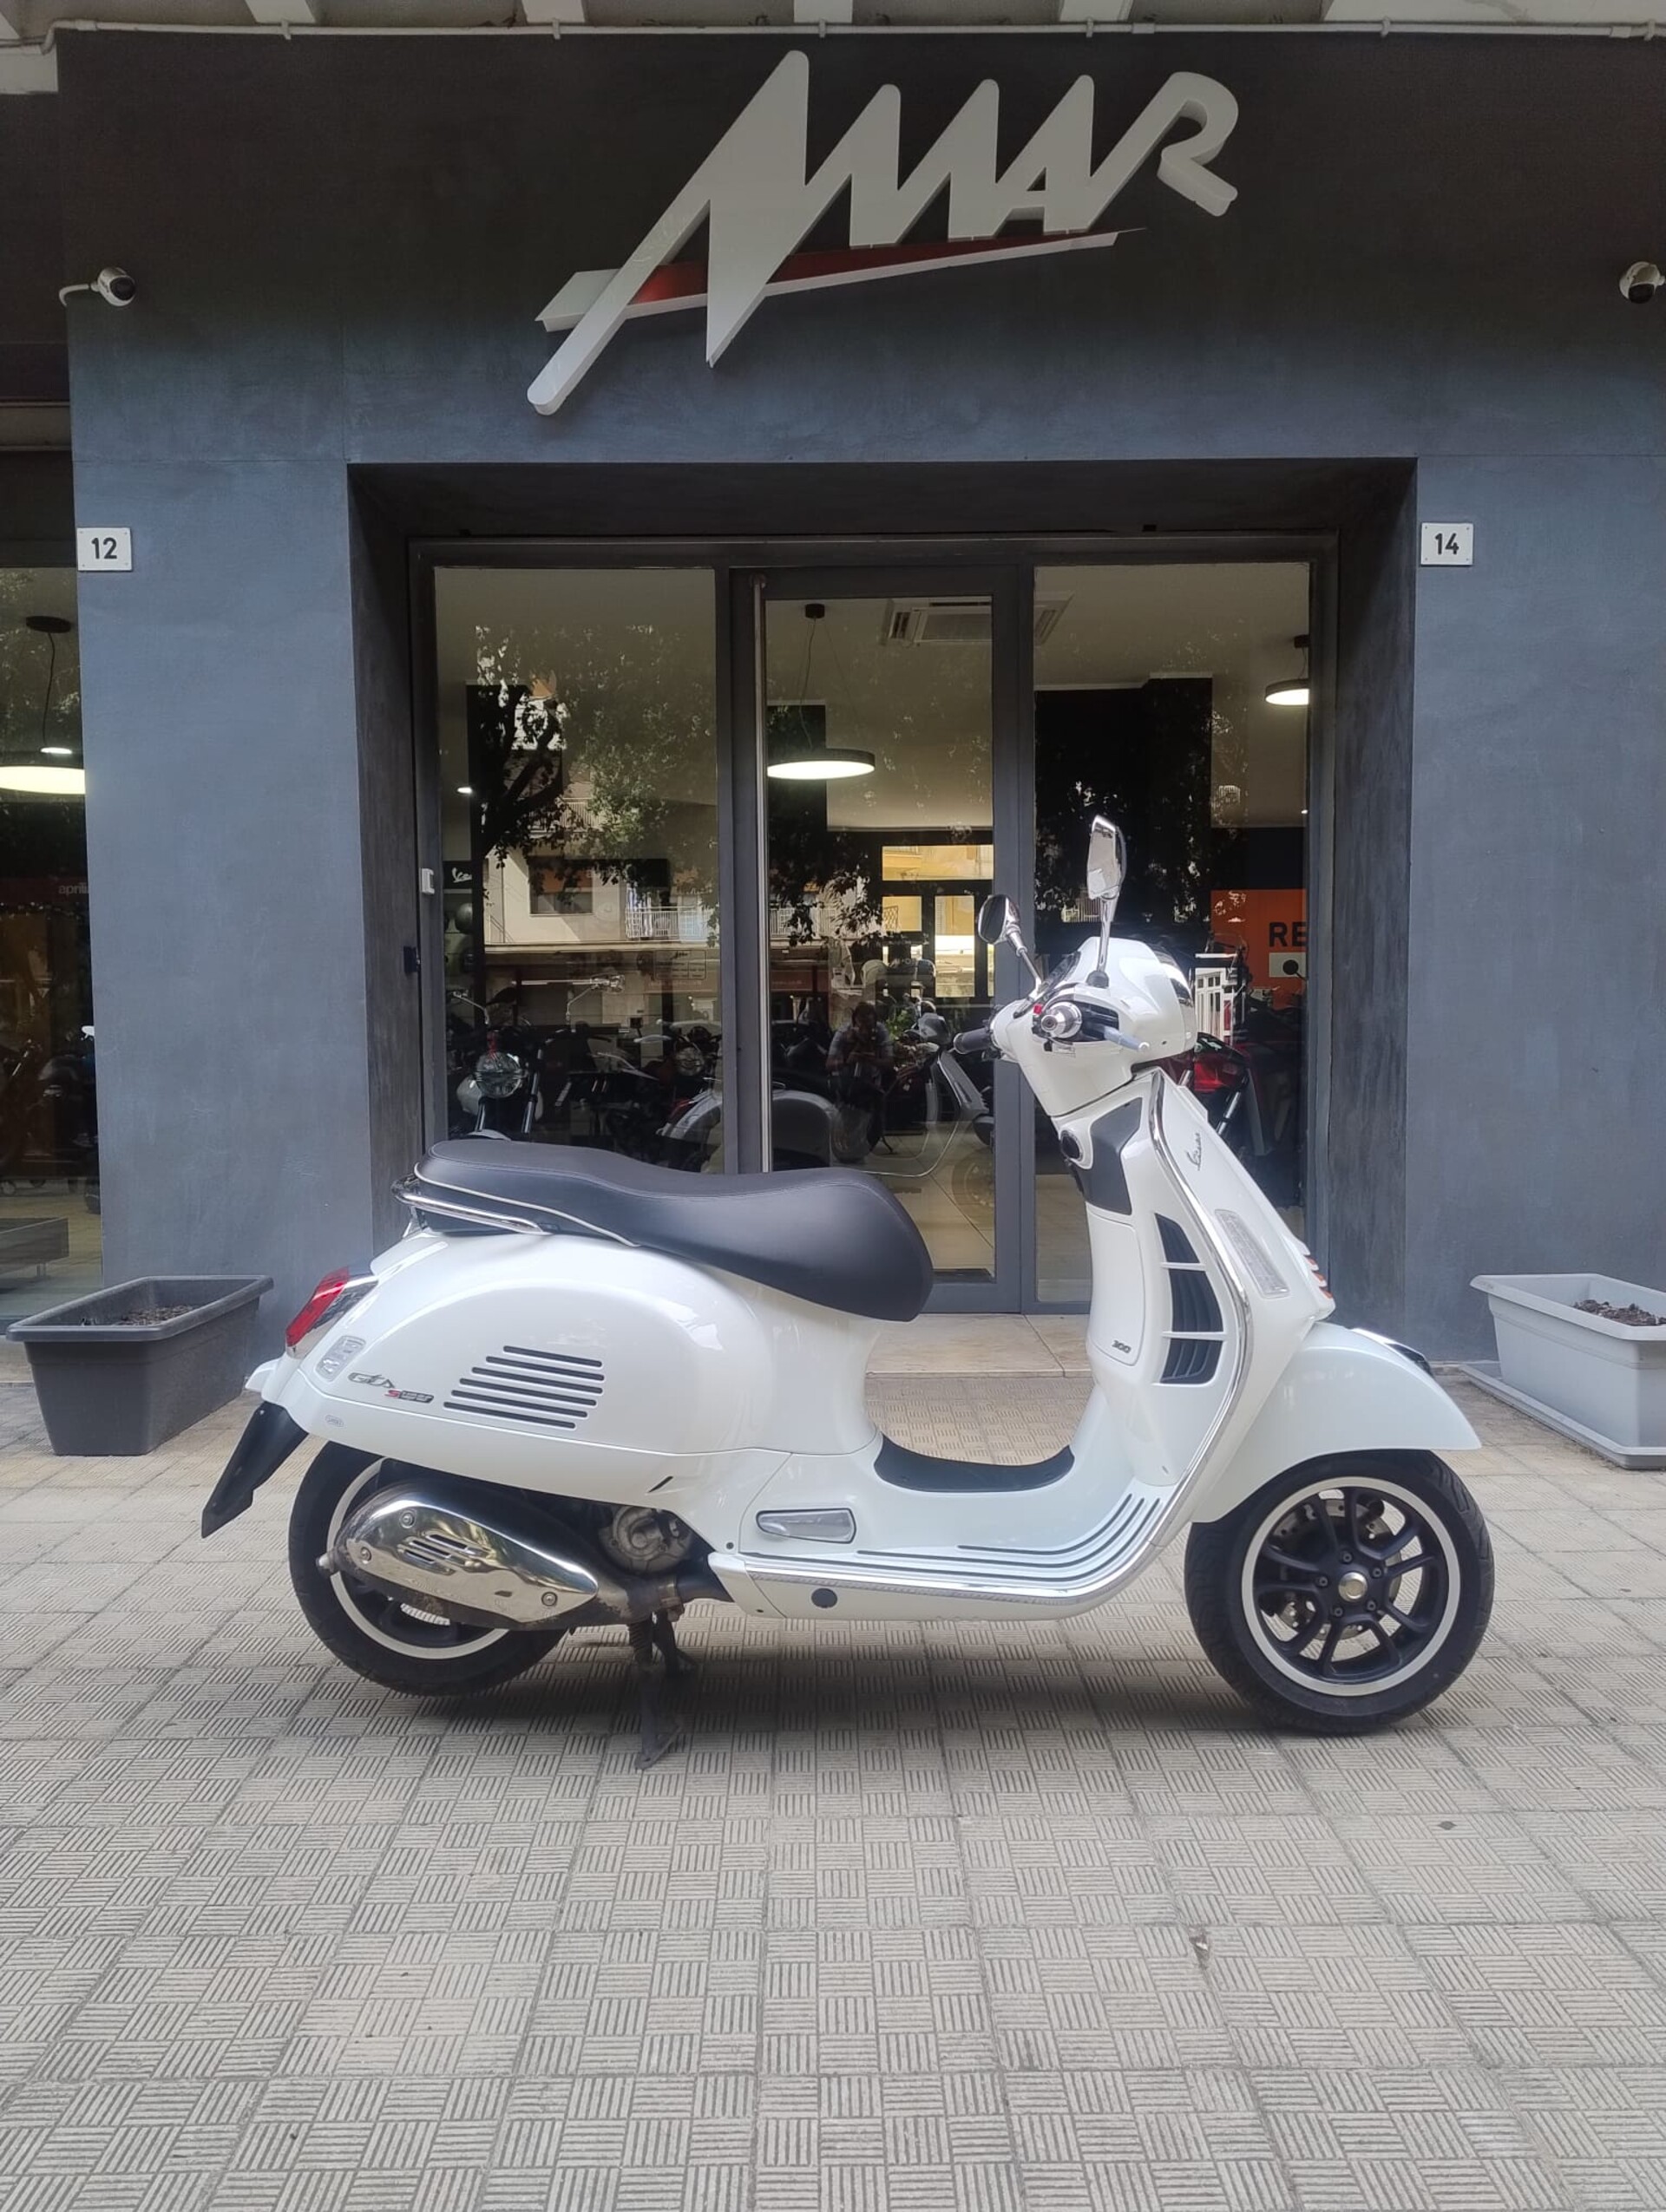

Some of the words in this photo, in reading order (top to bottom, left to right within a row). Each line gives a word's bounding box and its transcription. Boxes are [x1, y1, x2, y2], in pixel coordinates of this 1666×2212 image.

[91, 537, 118, 560] 12
[1434, 533, 1459, 555] 14
[1112, 1339, 1131, 1353] 300
